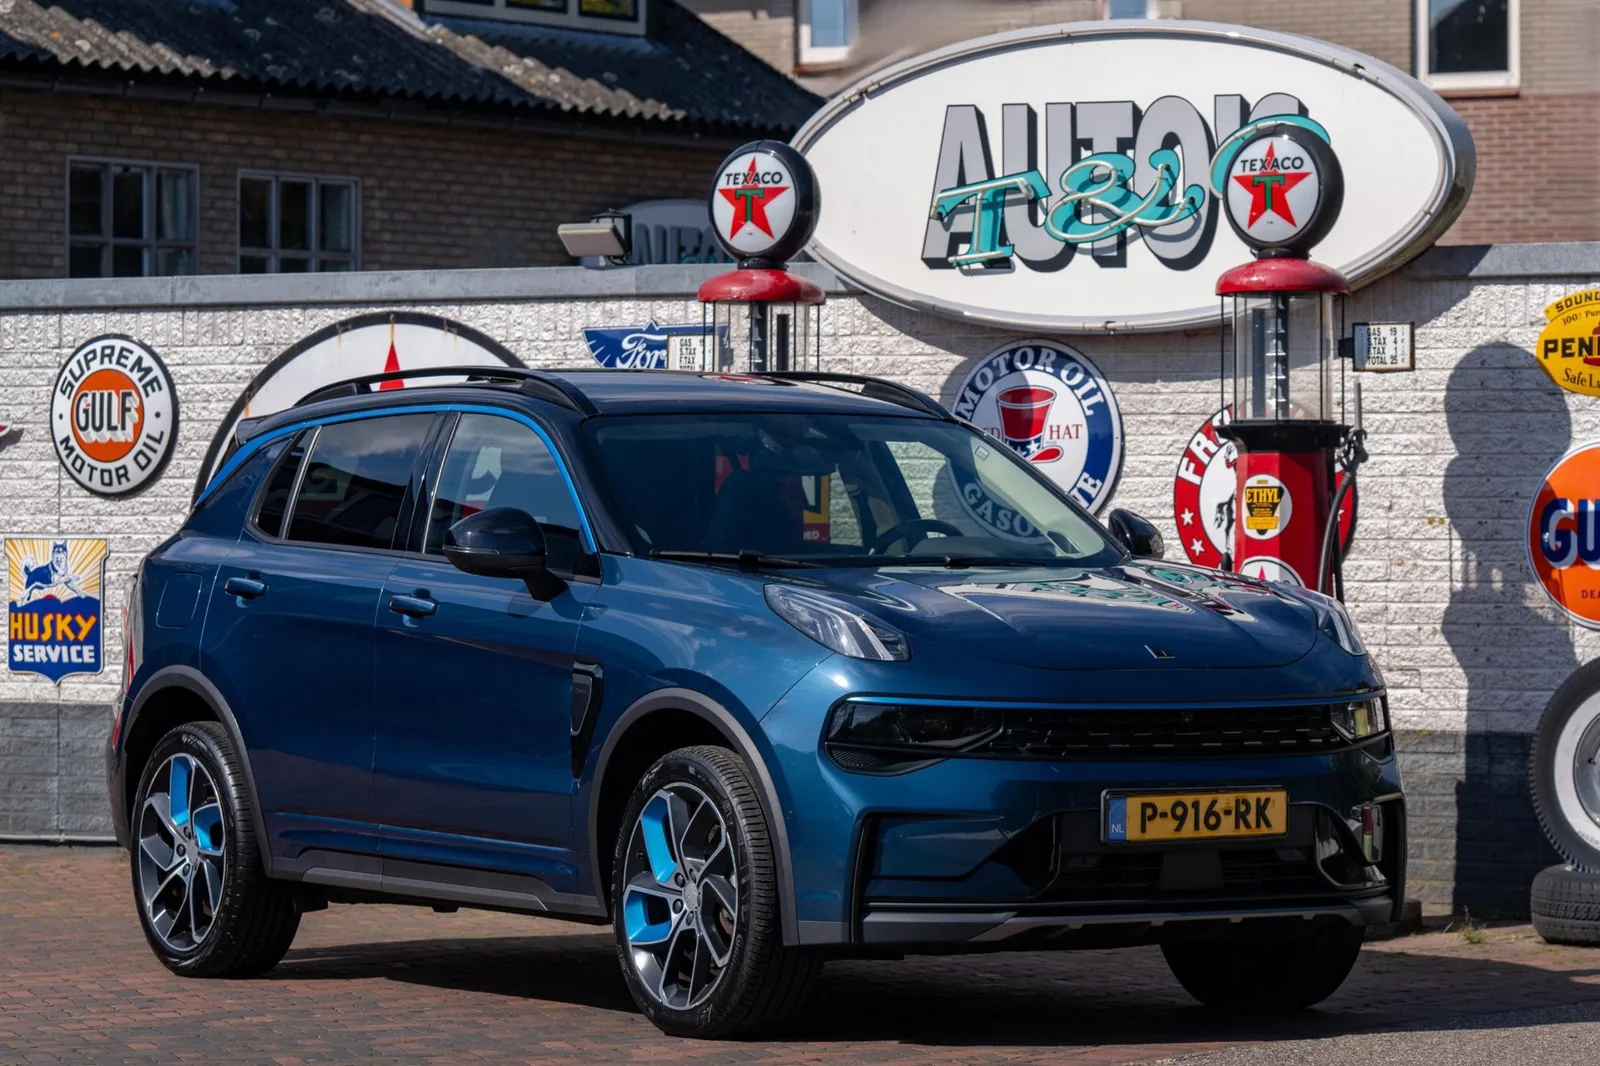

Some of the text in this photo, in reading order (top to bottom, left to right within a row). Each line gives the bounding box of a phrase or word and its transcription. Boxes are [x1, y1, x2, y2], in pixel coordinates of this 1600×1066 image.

[1241, 156, 1304, 172] TEXACO
[725, 171, 783, 186] TEXACO
[1253, 174, 1285, 210] T
[735, 188, 765, 222] T
[1367, 327, 1381, 336] GAS
[679, 347, 696, 356] S.TAX
[680, 338, 692, 347] GAS
[1543, 336, 1600, 360] PEN
[679, 356, 695, 365] F.TAX
[1366, 355, 1388, 365] TOTAL
[60, 345, 163, 400] SUPREME
[1562, 367, 1587, 387] Safe
[957, 347, 1105, 420] MOTOR OIL
[75, 389, 139, 443] GULF
[1049, 424, 1083, 440] HAT
[60, 430, 164, 487] MOTOR OIL
[1246, 487, 1281, 504] ETHYL
[9, 612, 98, 642] HUSKY
[13, 644, 95, 663] SERVICE
[1140, 797, 1272, 834] P-916-RK
[1111, 823, 1124, 833] NL
